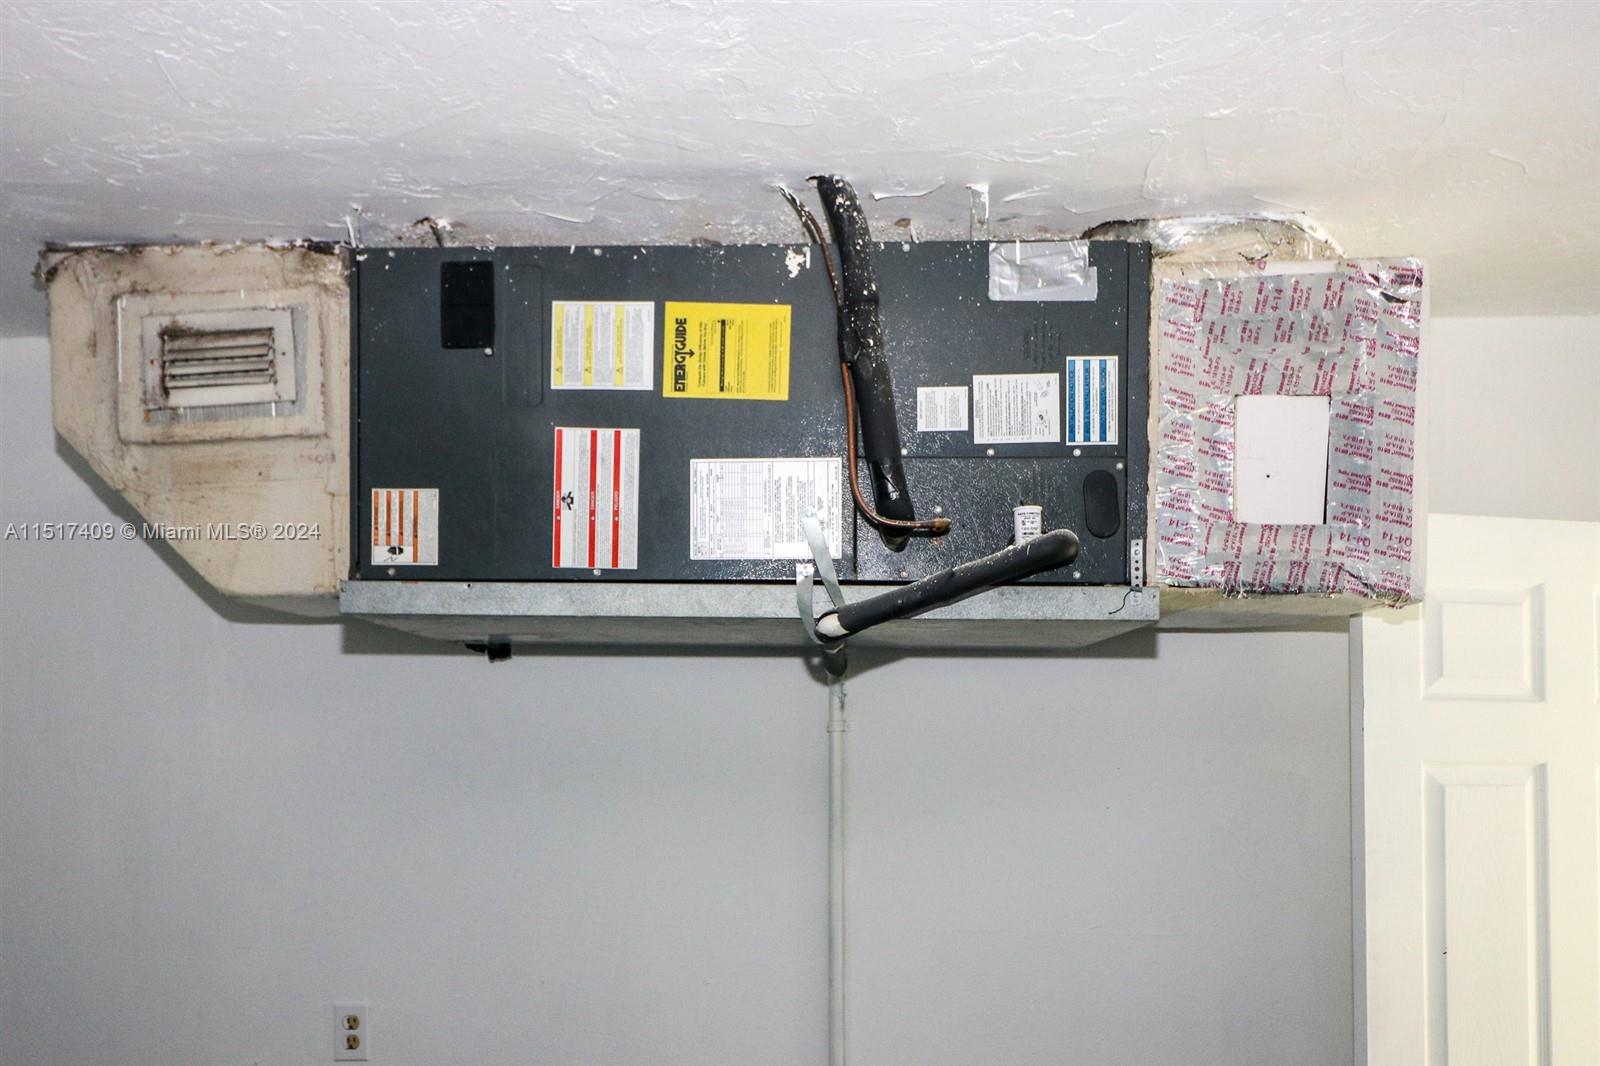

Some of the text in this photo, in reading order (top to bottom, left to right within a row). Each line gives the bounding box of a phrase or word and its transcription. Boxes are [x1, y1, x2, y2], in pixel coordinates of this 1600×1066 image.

[1271, 288, 1283, 312] 4-14
[674, 318, 689, 392] ENERGYGUIDE
[1340, 532, 1371, 547] Q4-14
[1382, 531, 1412, 547] Q4-14
